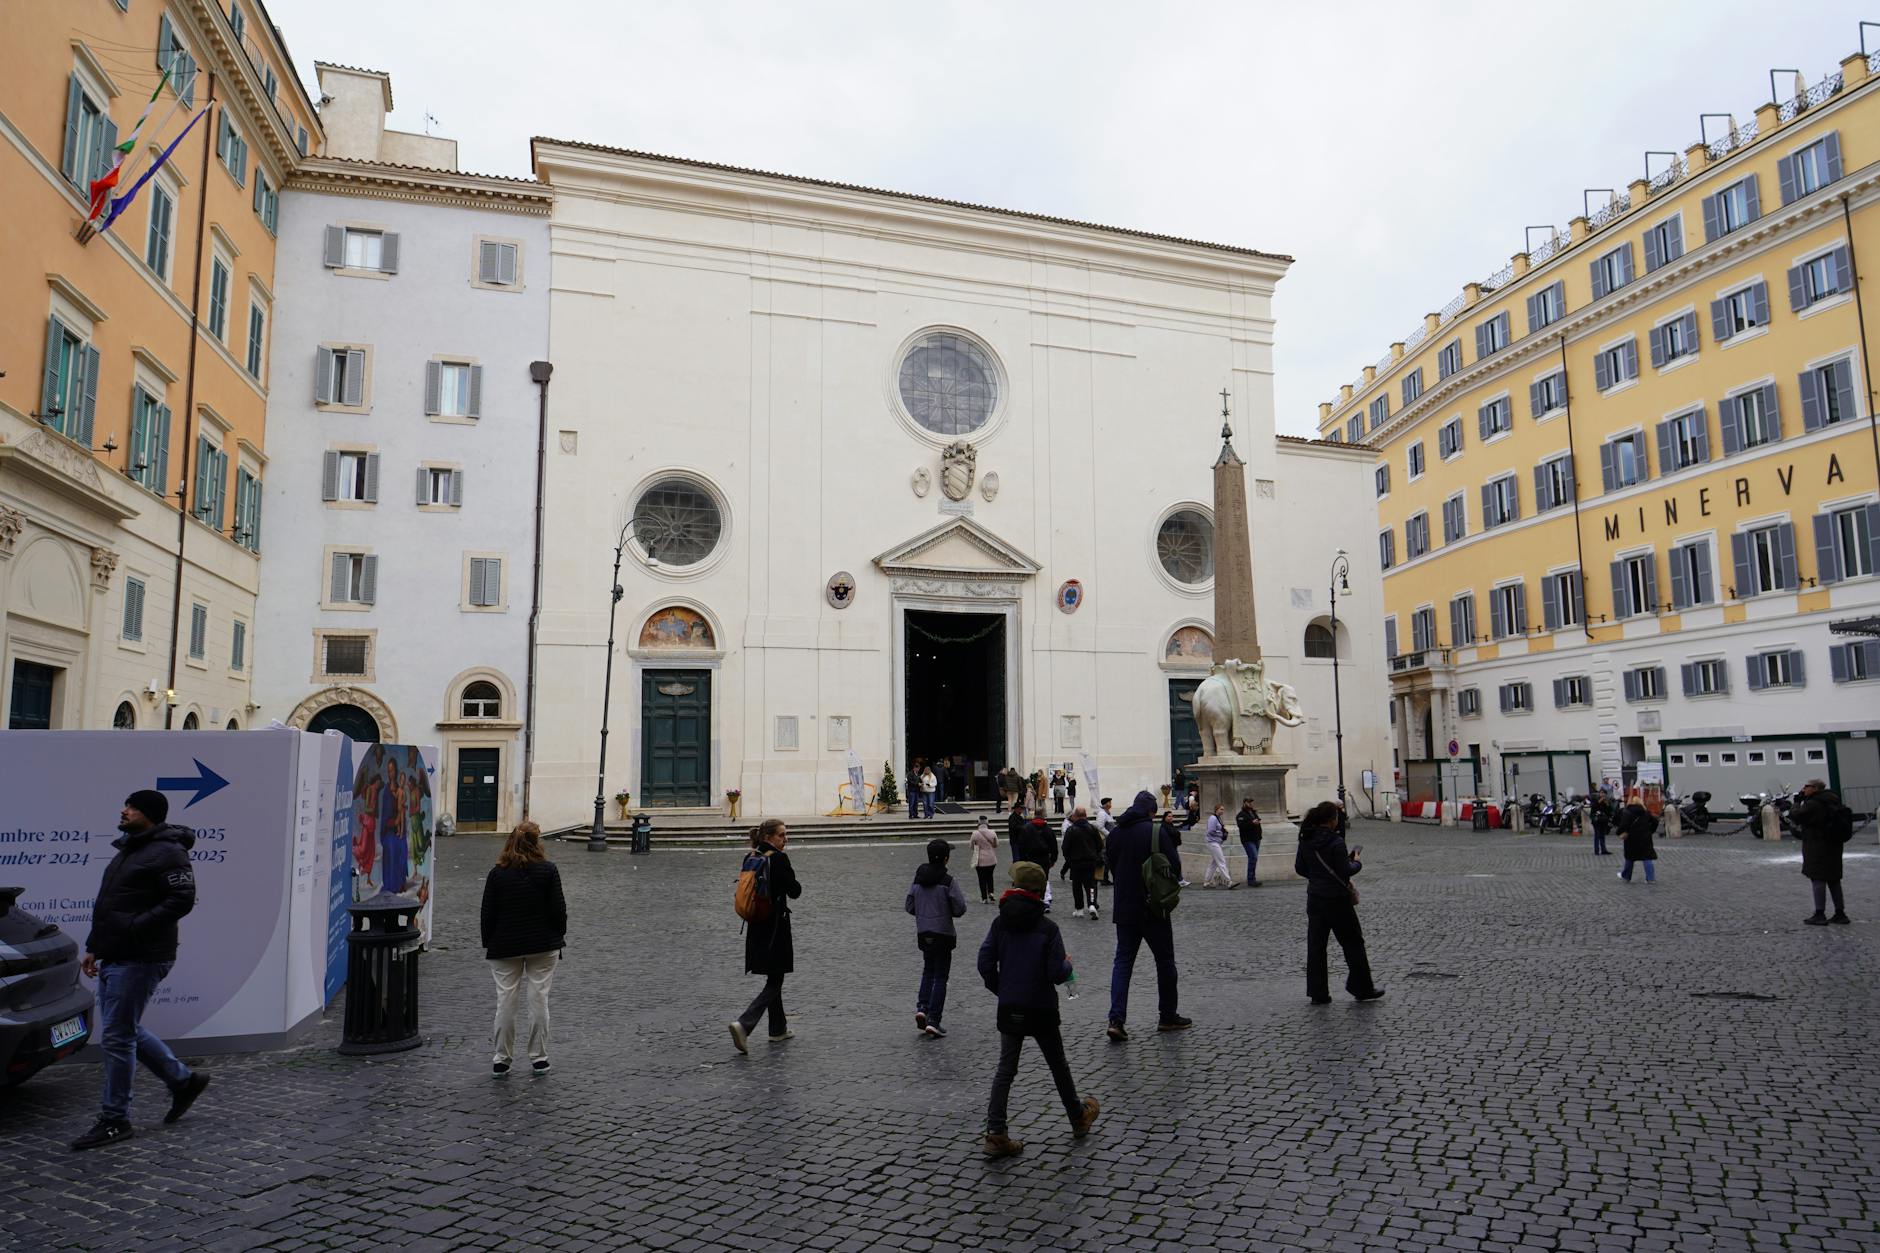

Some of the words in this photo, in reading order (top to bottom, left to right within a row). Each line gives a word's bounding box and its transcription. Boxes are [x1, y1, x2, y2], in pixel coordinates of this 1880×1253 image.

[1604, 453, 1845, 541] MINERVA
[49, 830, 90, 844] 2024
[48, 853, 90, 866] 2024
[189, 850, 228, 864] 2025
[21, 902, 45, 911] con
[49, 899, 57, 910] il
[43, 913, 59, 923] the
